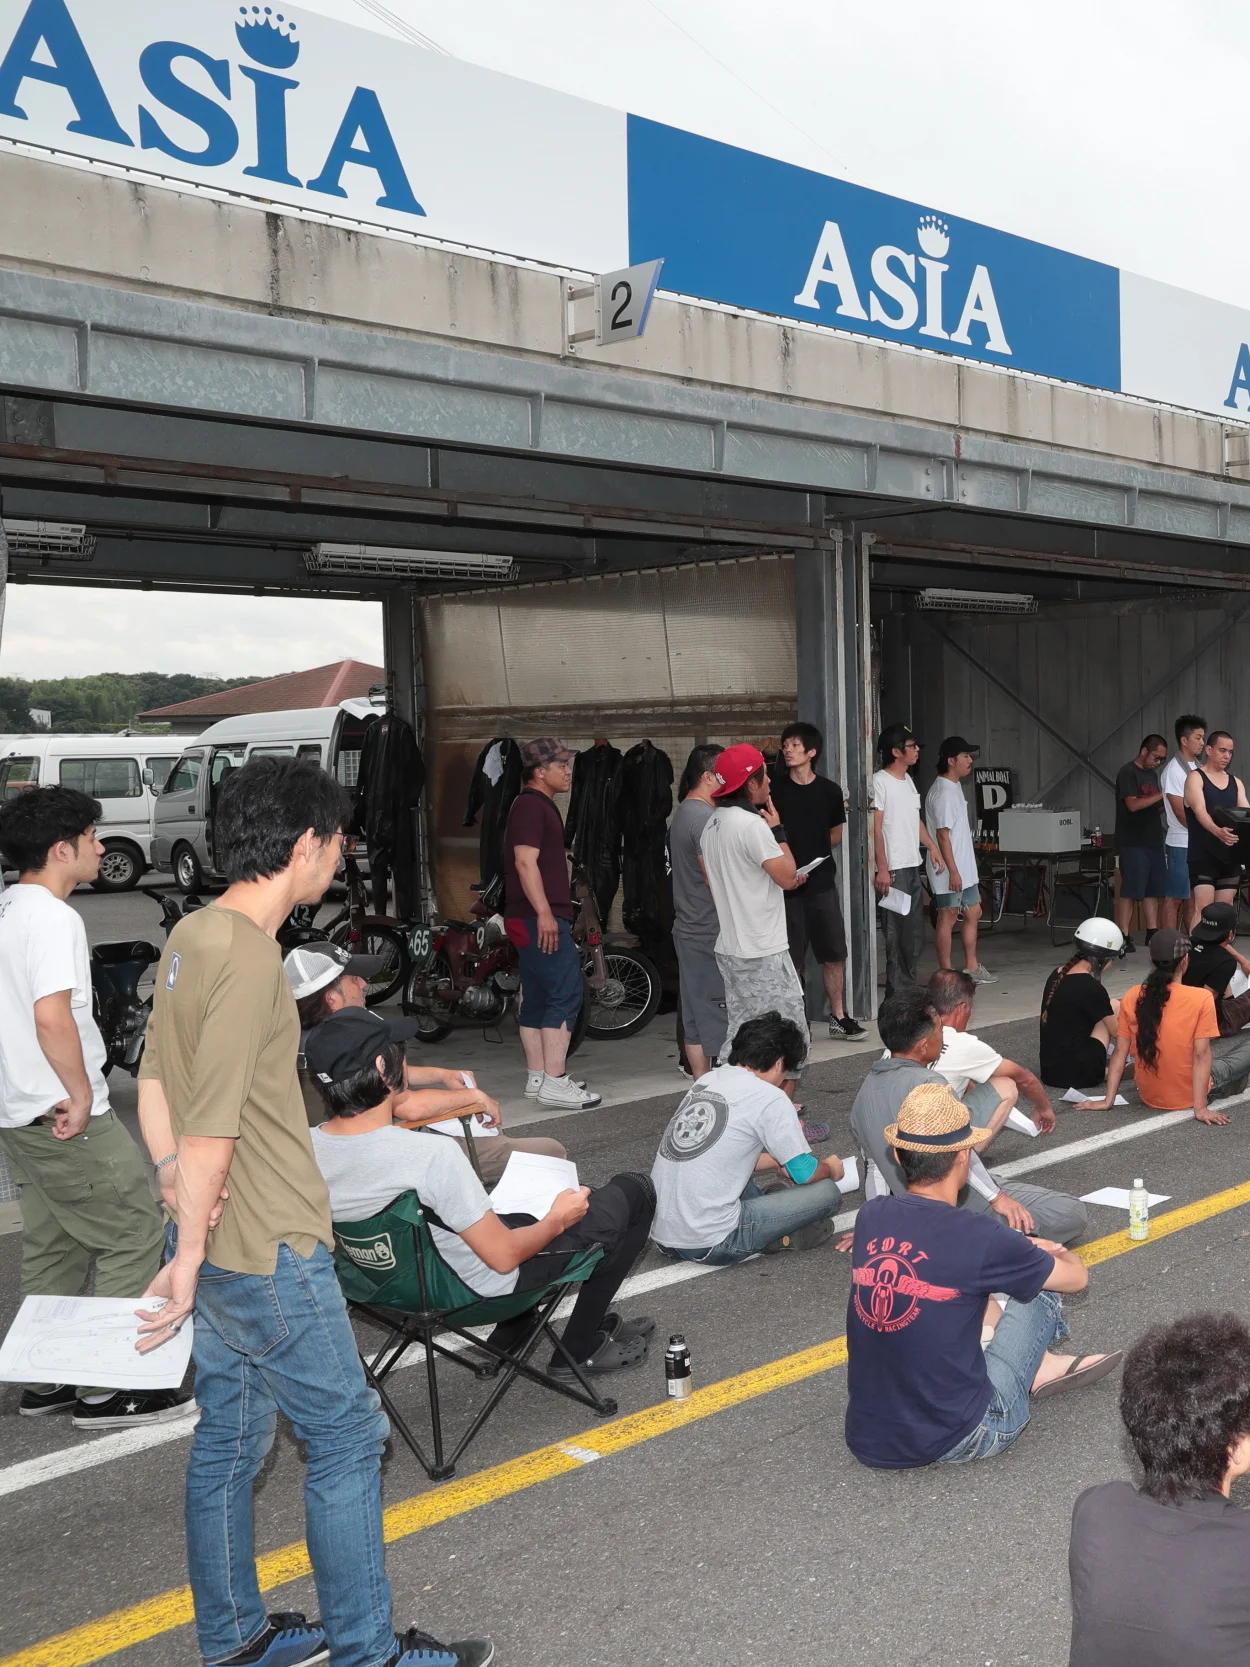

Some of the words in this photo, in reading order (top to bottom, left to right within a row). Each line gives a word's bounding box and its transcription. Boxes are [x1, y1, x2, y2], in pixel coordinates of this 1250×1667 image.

[0, 0, 427, 217] ASIA
[610, 280, 633, 330] 2
[793, 217, 1012, 355] ASIA
[982, 784, 1007, 810] D
